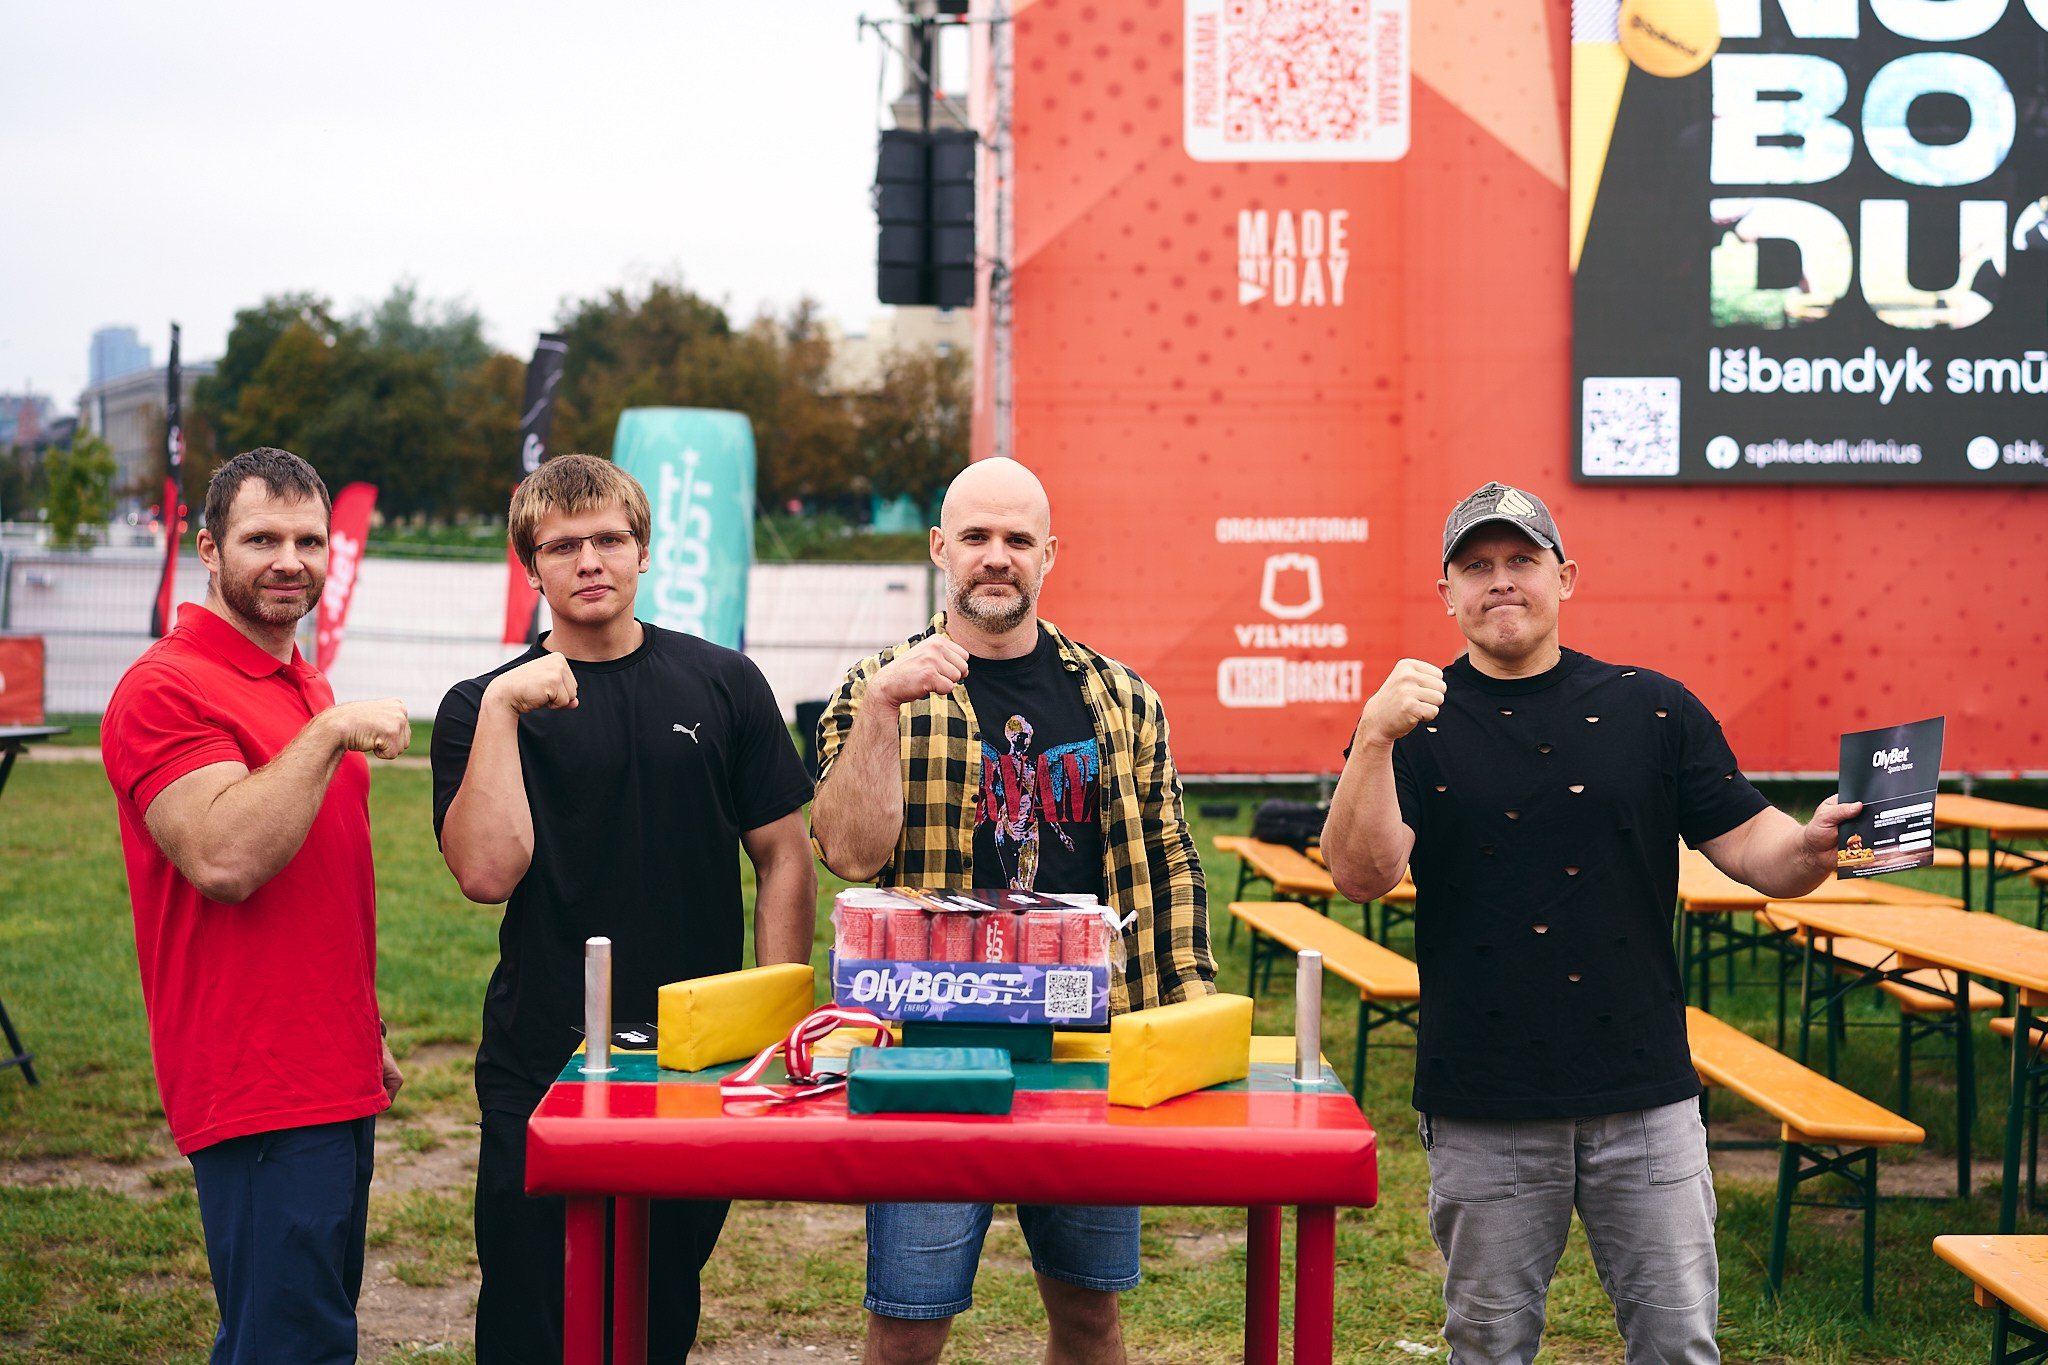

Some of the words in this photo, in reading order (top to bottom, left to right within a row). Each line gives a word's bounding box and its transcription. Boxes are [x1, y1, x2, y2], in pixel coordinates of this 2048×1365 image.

[1709, 51, 2016, 187] BO
[1238, 208, 1350, 258] MADE
[1273, 257, 1350, 307] DAY
[1709, 197, 2048, 330] DU
[1708, 346, 1934, 405] Išbandyk
[1234, 624, 1348, 648] VILNIUS
[1872, 746, 1910, 770] OlyBet
[852, 969, 1023, 1012] OlyBOOST
[903, 1003, 929, 1013] ENERGY
